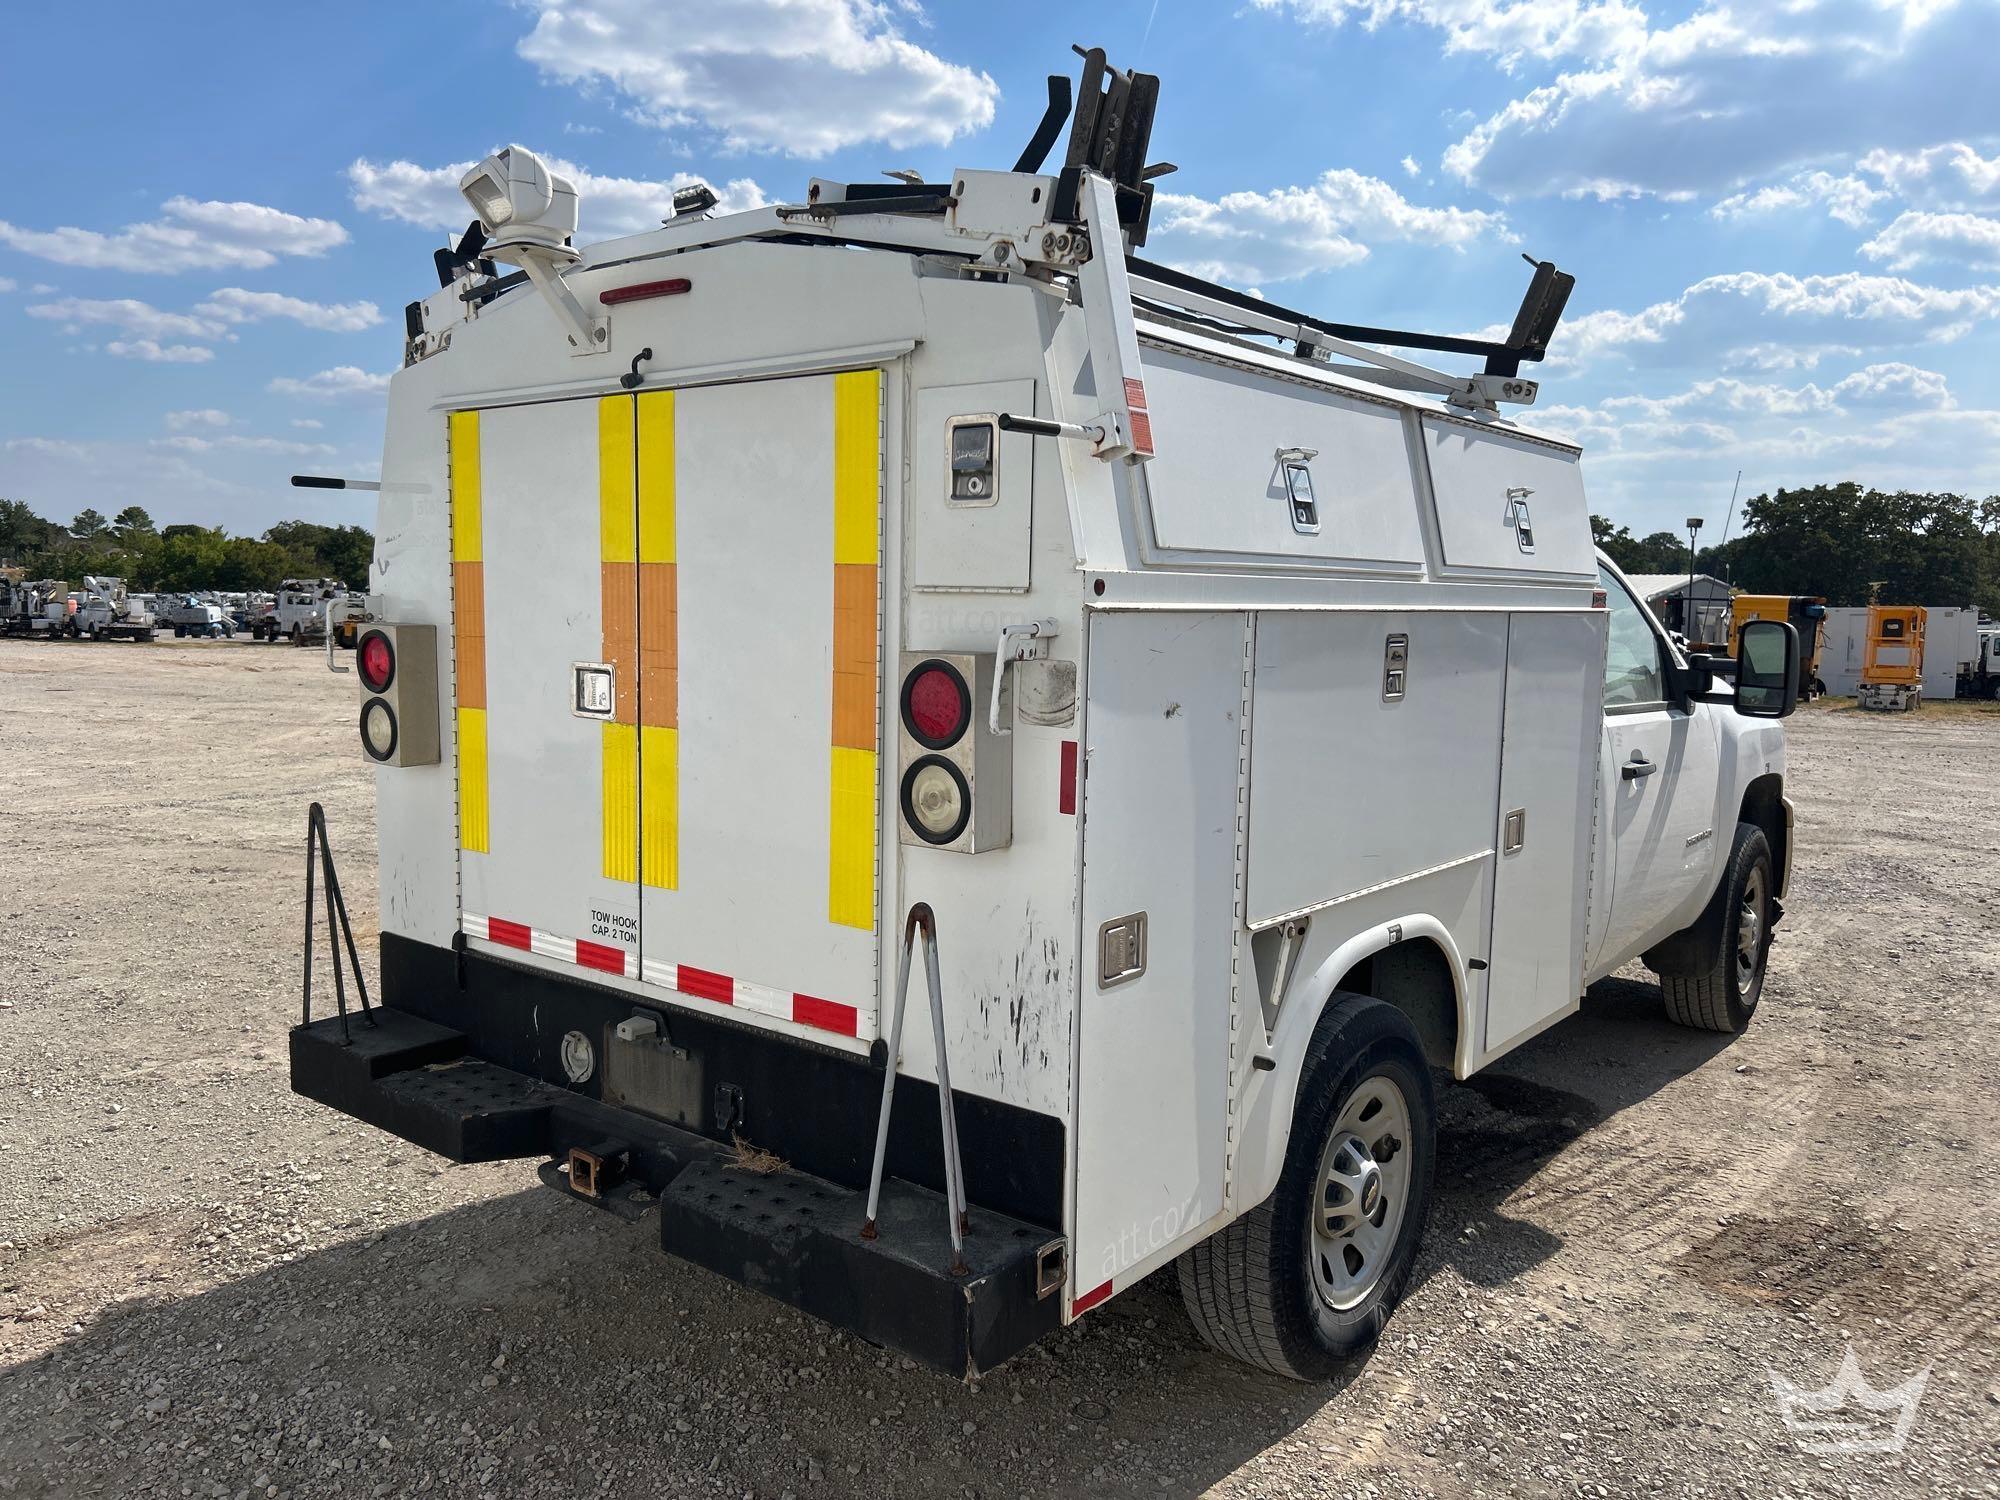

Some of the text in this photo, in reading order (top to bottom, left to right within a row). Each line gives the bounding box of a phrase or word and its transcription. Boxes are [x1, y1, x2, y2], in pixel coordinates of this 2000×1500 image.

[591, 909, 638, 931] TOW HOOK
[591, 923, 637, 944] CAP. 2 TON
